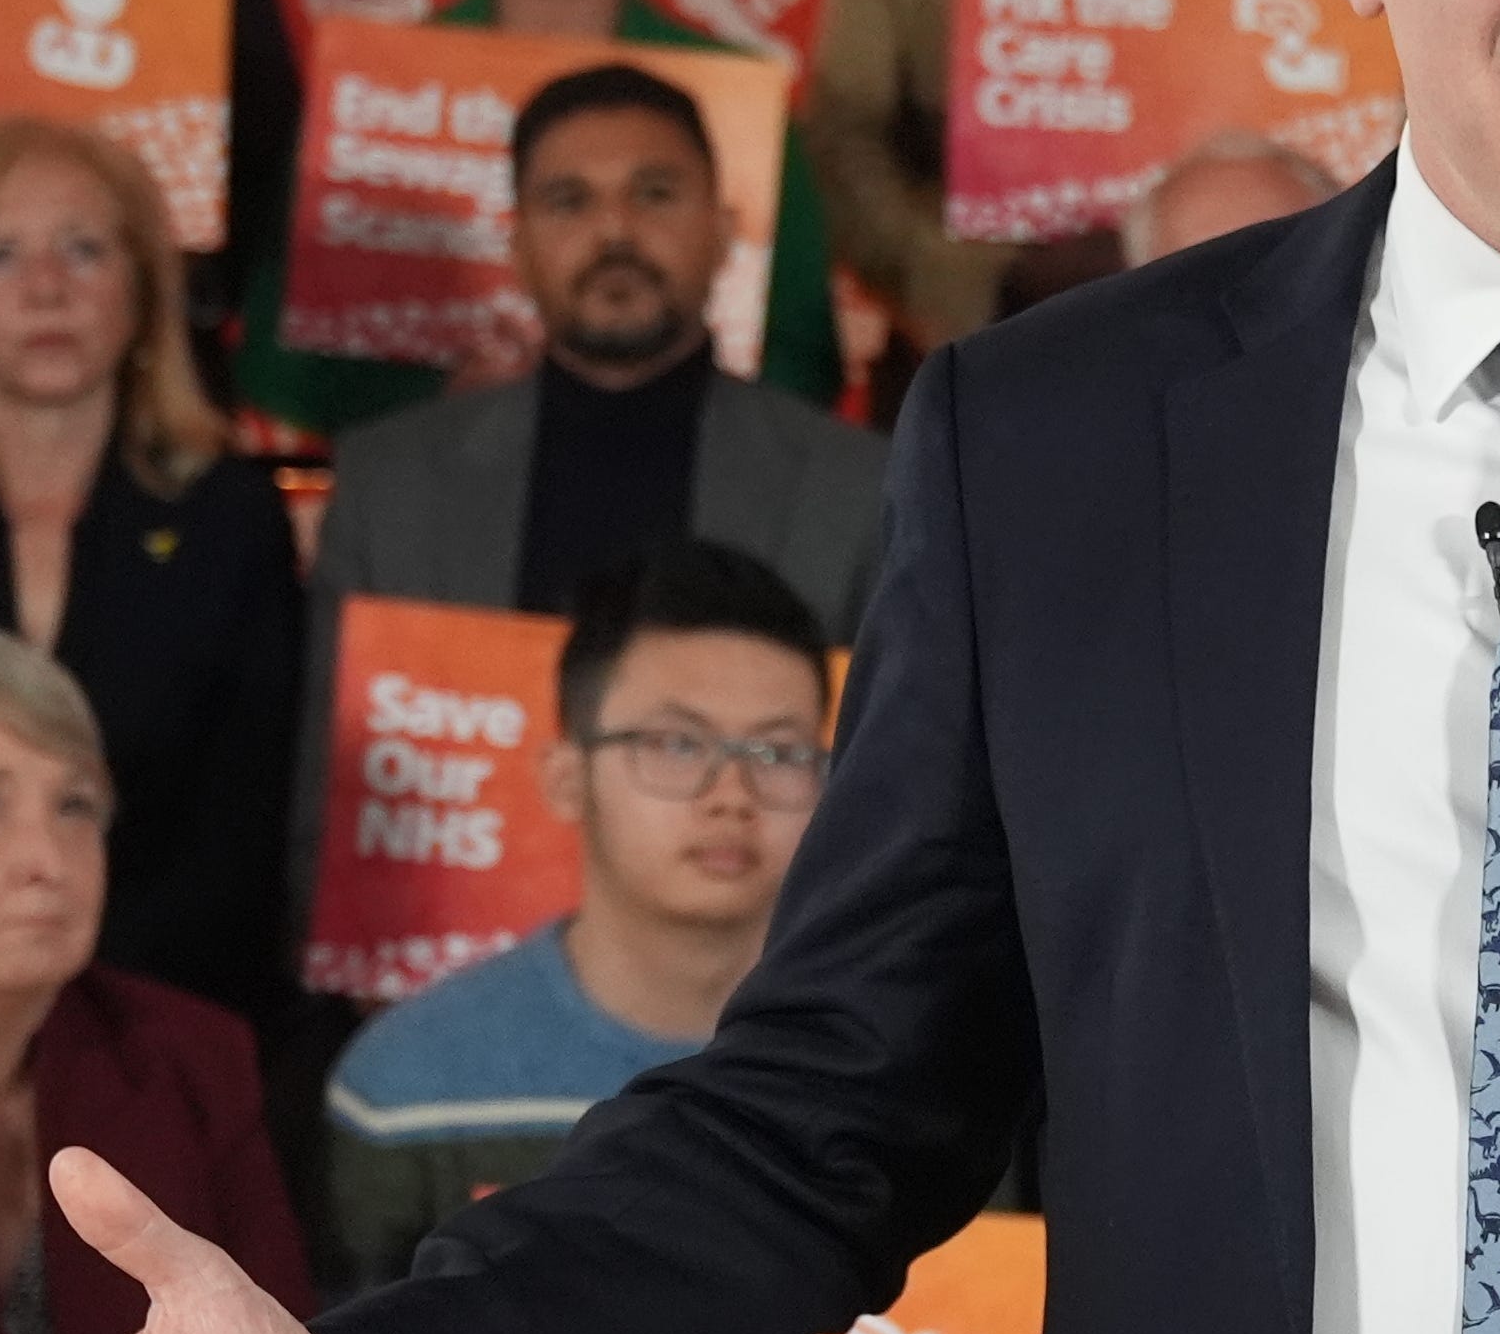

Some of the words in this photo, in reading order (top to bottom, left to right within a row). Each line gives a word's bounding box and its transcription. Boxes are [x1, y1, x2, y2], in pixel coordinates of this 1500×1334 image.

[367, 672, 527, 749] Save
[361, 738, 495, 804] Our
[357, 800, 503, 871] NHS
